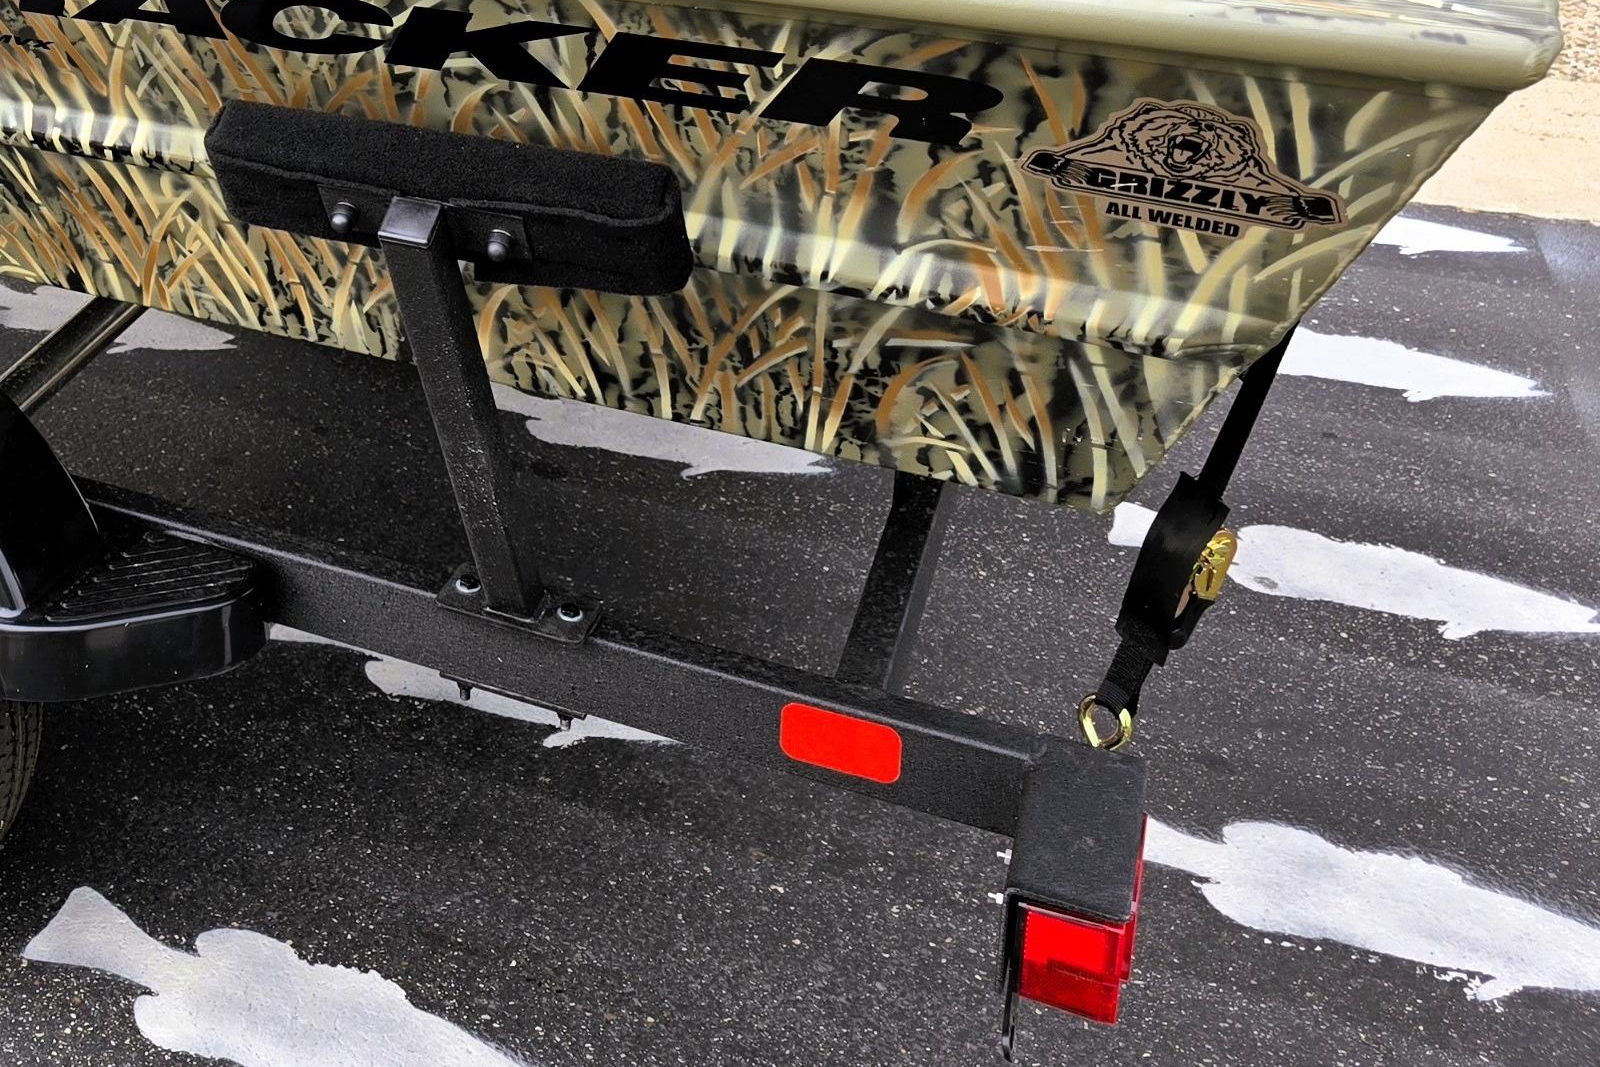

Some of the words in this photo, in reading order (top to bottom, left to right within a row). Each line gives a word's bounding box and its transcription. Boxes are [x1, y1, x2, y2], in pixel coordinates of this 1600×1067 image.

[1086, 166, 1268, 216] GRIZZLY
[1105, 201, 1142, 220] ALL
[1148, 208, 1240, 238] WELDED
